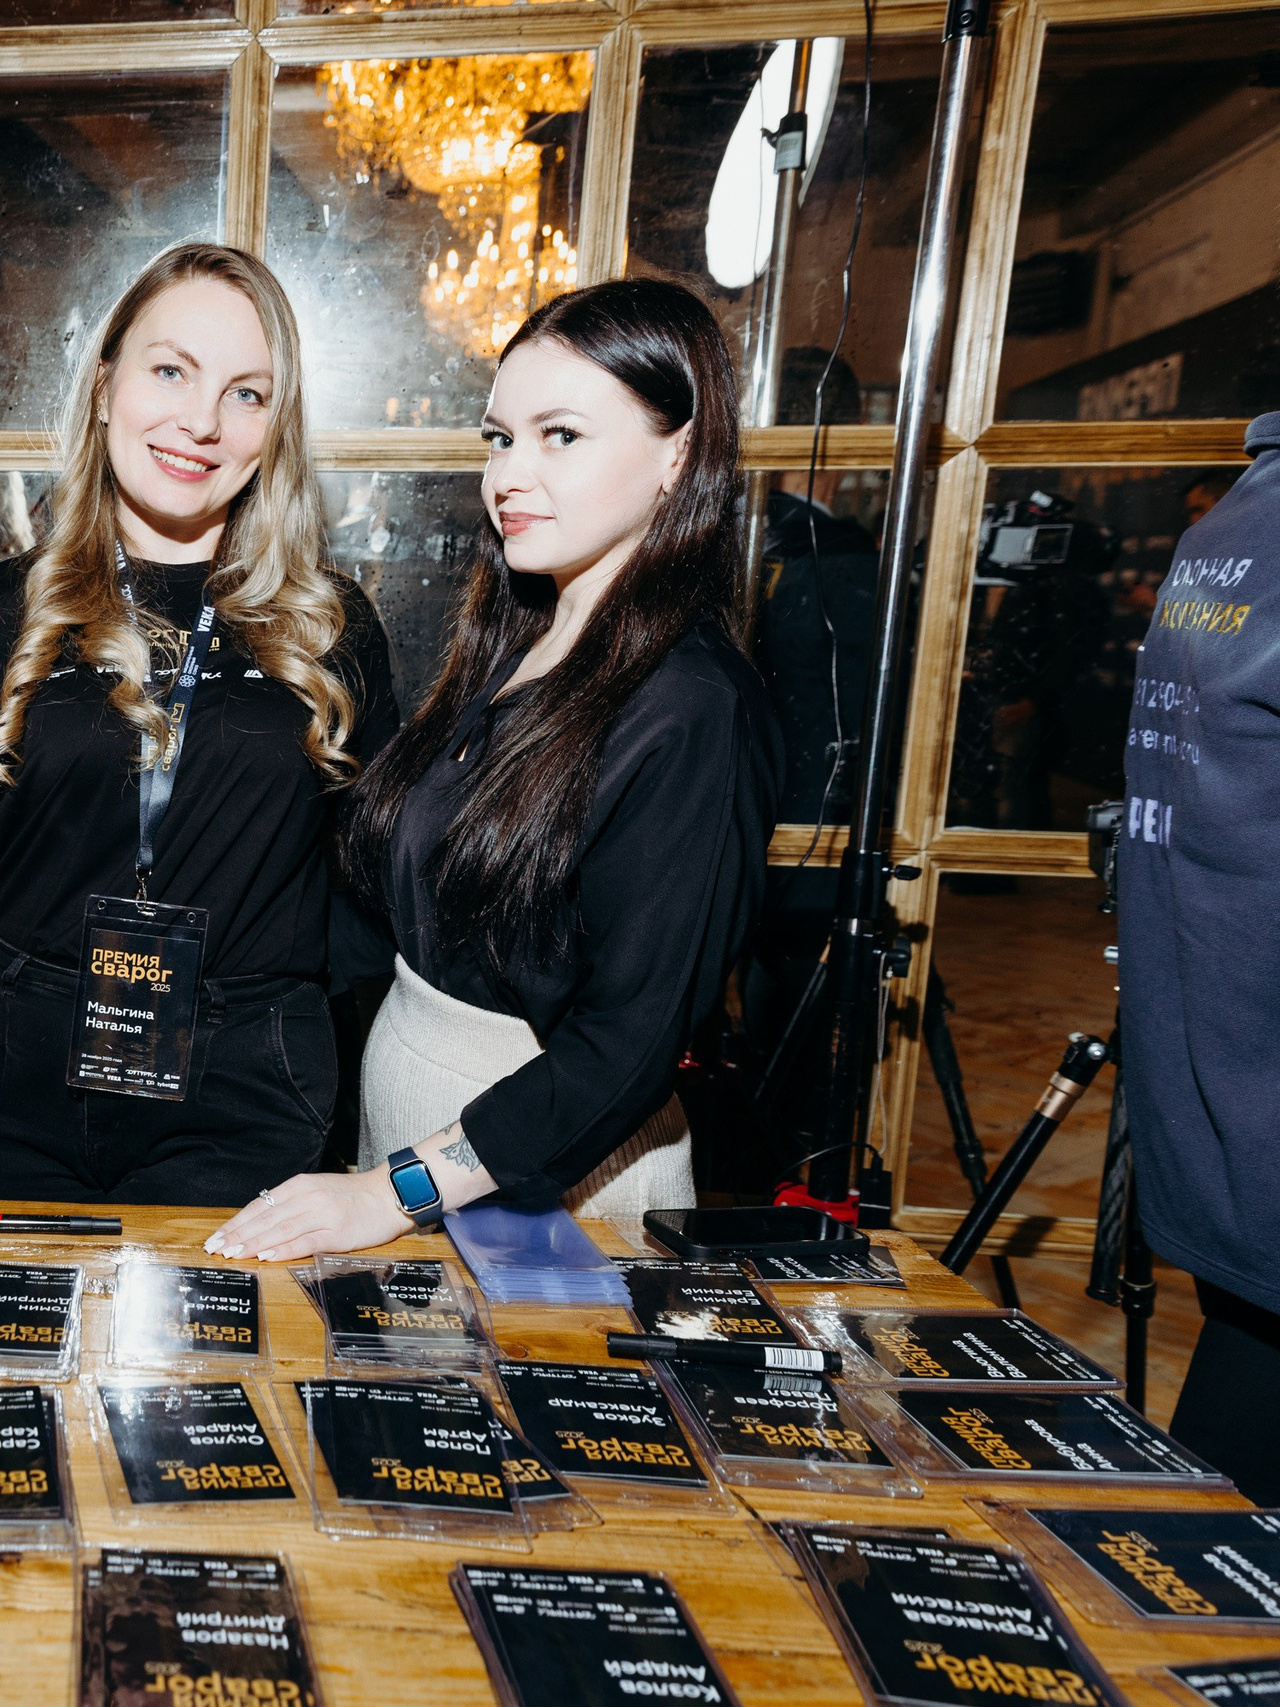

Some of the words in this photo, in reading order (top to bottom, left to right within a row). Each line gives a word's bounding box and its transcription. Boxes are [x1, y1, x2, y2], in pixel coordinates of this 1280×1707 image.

[1172, 558, 1253, 587] ОКОННАЯ
[197, 606, 216, 632] VEKA
[161, 724, 177, 772] сварог
[92, 948, 160, 968] ПРЕМИЯ
[91, 962, 173, 983] сварог
[151, 983, 171, 993] 2025
[88, 1001, 154, 1020] Мальгина
[85, 1017, 142, 1034] Наталья
[380, 1285, 449, 1294] Алексей
[388, 1292, 452, 1301] Марков
[681, 1288, 754, 1297] Евгений
[19, 1305, 69, 1313] Томин
[200, 1296, 250, 1306] Павел
[693, 1296, 761, 1305] Ерёмин
[358, 1311, 462, 1321] сварог
[377, 1318, 463, 1329] ПРЕМИЯ
[873, 1334, 932, 1377] ПРЕМИЯ
[879, 1327, 950, 1377] сварог
[953, 1340, 1005, 1378] Вьюгина
[963, 1332, 1027, 1378] Валентина
[734, 1396, 838, 1412] Дорофеев
[767, 1389, 831, 1401] Павел
[548, 1398, 656, 1415] Александр
[593, 1412, 666, 1426] Зубков
[732, 1416, 762, 1424] 2025
[183, 1423, 257, 1435] Андрей
[423, 1428, 487, 1442] Артём
[740, 1423, 863, 1441] сварог
[948, 1407, 1031, 1469] сварог
[190, 1434, 264, 1445] Окулов
[424, 1440, 491, 1455] Попов
[561, 1437, 684, 1456] сварог
[764, 1435, 872, 1451] ПРЕМИЯ
[940, 1416, 1014, 1468] ПРЕМИЯ
[1025, 1419, 1094, 1470] Бабурова
[156, 1460, 185, 1468] 2025
[371, 1458, 401, 1466] 2025
[584, 1449, 691, 1467] ПРЕМИЯ
[1077, 1443, 1119, 1470] Анна
[161, 1463, 281, 1480] сварог
[373, 1466, 500, 1487] сварог
[184, 1476, 287, 1490] ПРЕМИЯ
[396, 1479, 504, 1499] ПРЕМИЯ
[1097, 1543, 1198, 1615] ПРЕМИЯ
[1102, 1531, 1218, 1615] сварог
[891, 1592, 1032, 1622] Анастасия
[176, 1611, 285, 1632] Дмитрий
[902, 1609, 1049, 1641] Горчакова
[182, 1629, 289, 1650] Назаров
[604, 1660, 706, 1682] Андрей
[915, 1652, 1084, 1689] сварог
[144, 1671, 299, 1700] сварог
[620, 1680, 720, 1702] Козлов
[948, 1670, 1098, 1705] ПРЕМИЯ
